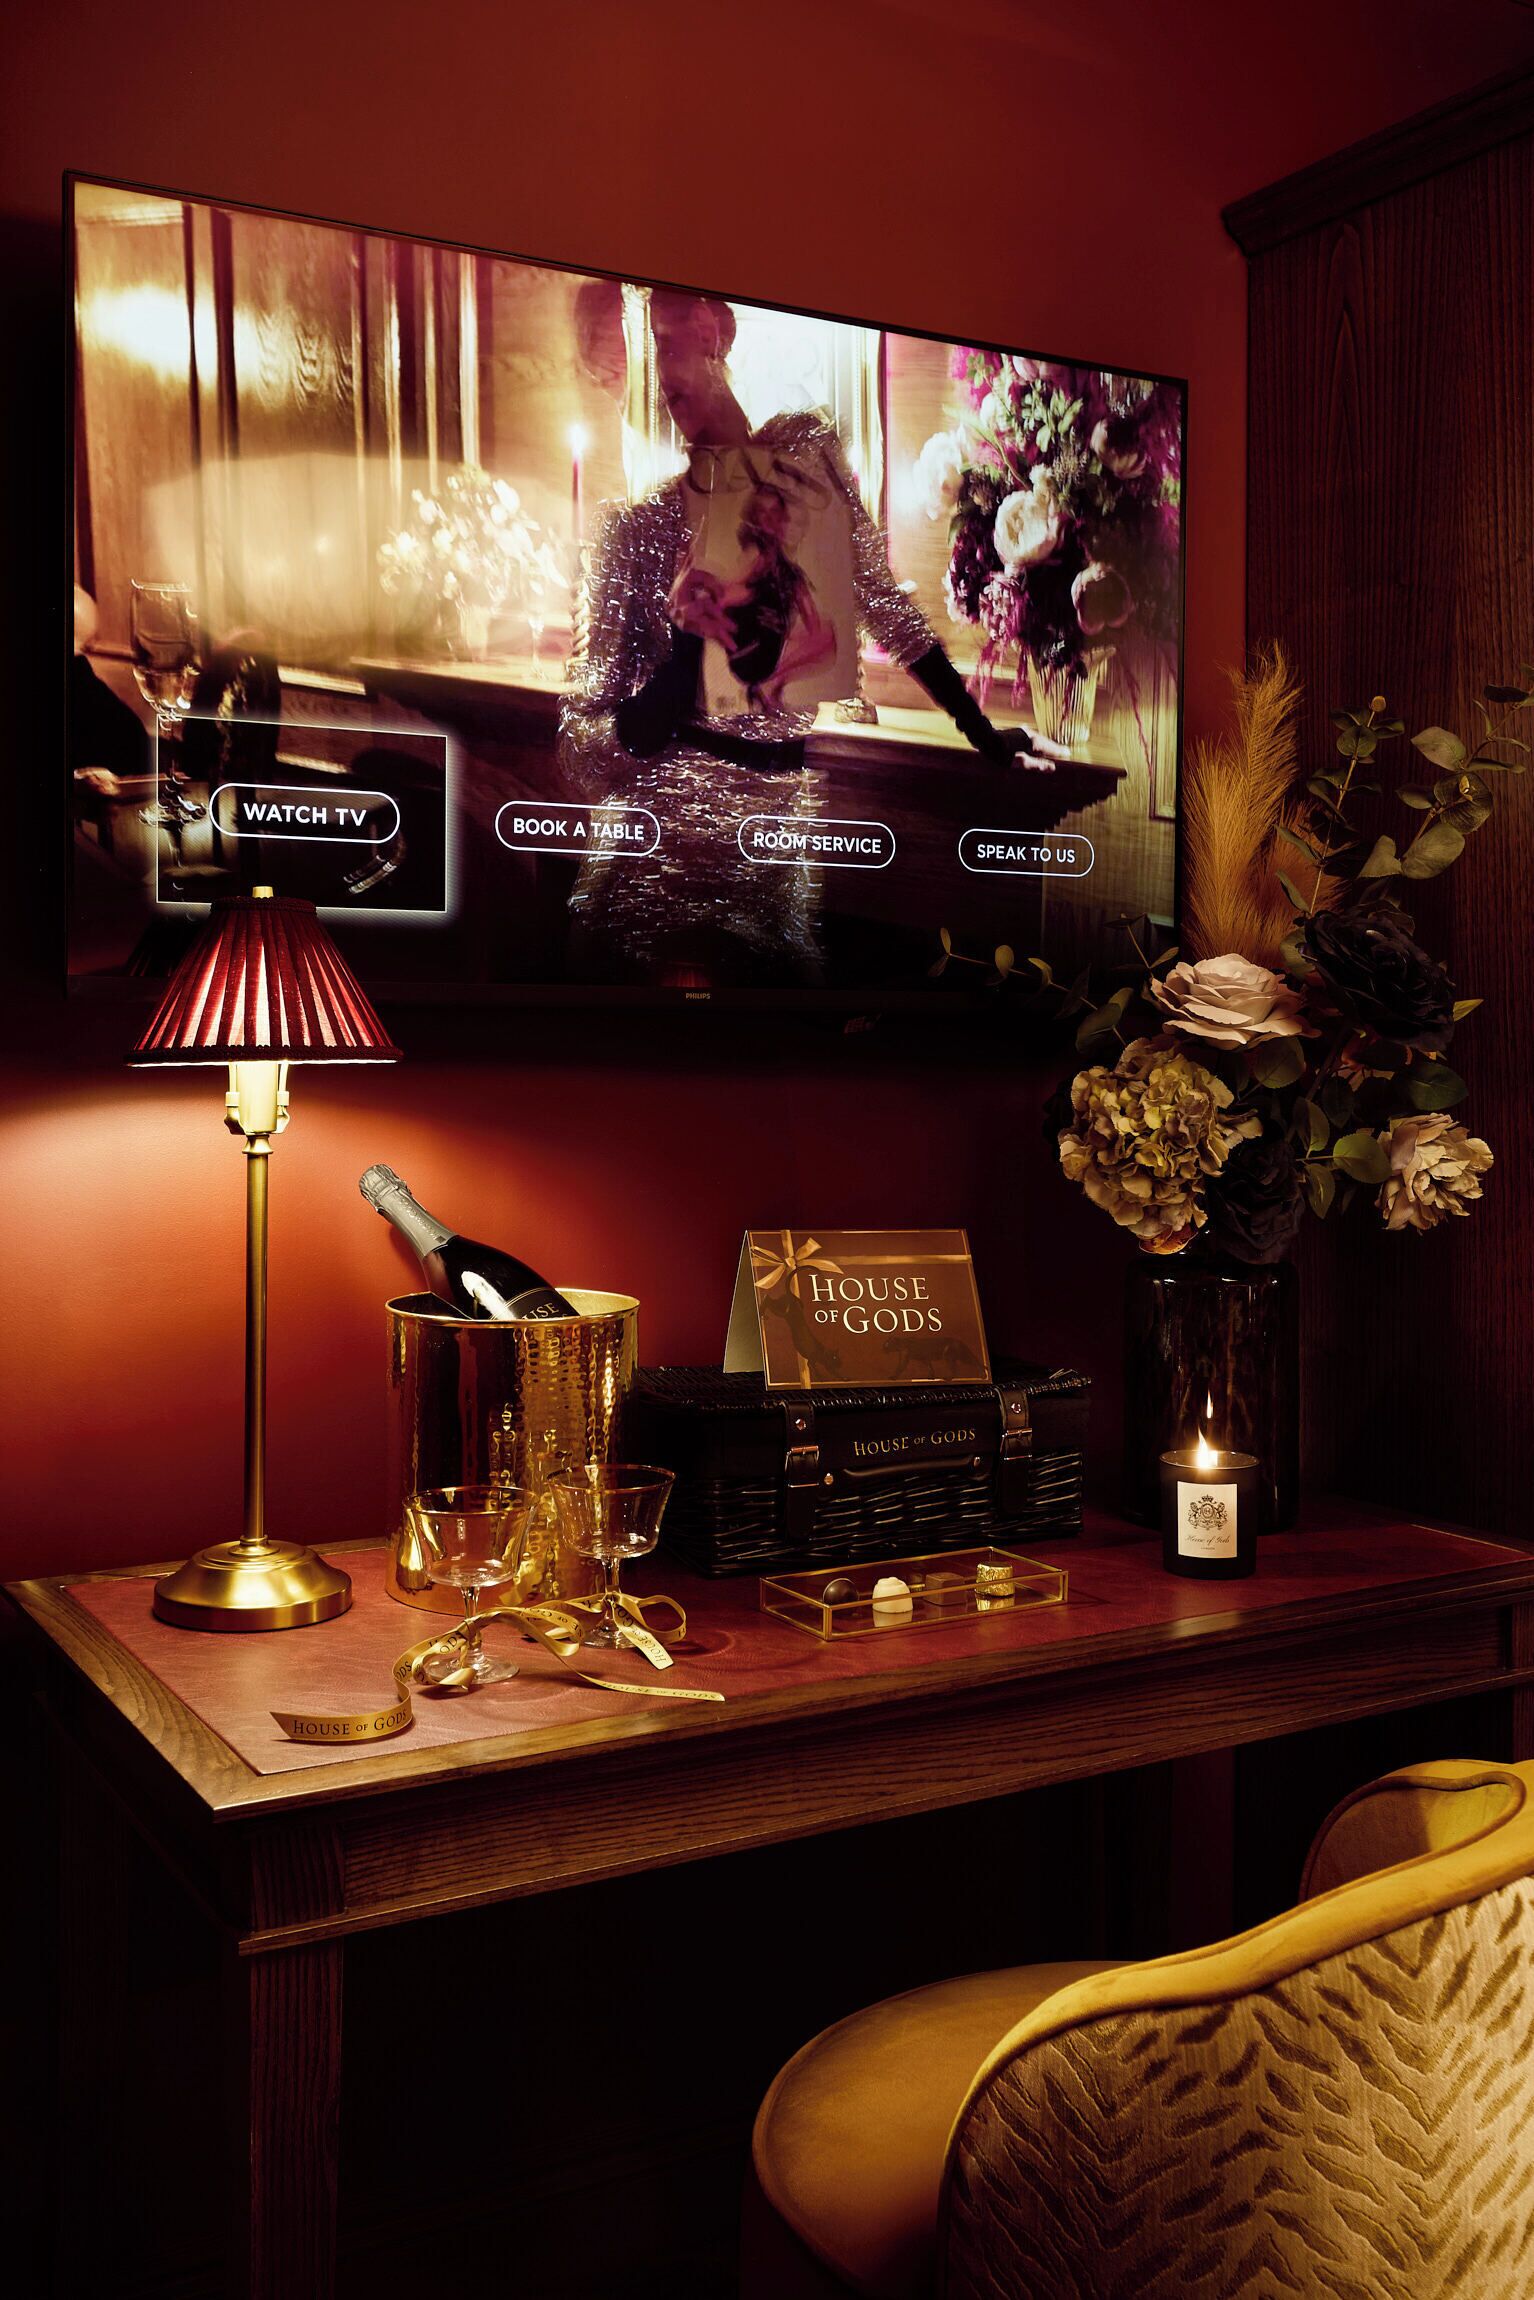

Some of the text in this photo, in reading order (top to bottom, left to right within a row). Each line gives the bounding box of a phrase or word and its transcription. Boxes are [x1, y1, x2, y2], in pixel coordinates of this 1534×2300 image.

[243, 802, 367, 827] WATCH TV
[513, 817, 645, 841] BOOK A TABLE
[753, 831, 882, 854] ROOM SERVICE
[977, 844, 1076, 863] SPEAK TO US
[685, 992, 711, 1000] PHILIPS
[808, 1273, 930, 1302] HOUSE
[814, 1305, 943, 1334] OF GODS
[853, 1436, 909, 1456] HOUSE
[930, 1428, 976, 1445] GODS
[293, 1719, 351, 1736] HOUSE
[373, 1708, 407, 1731] GODS
